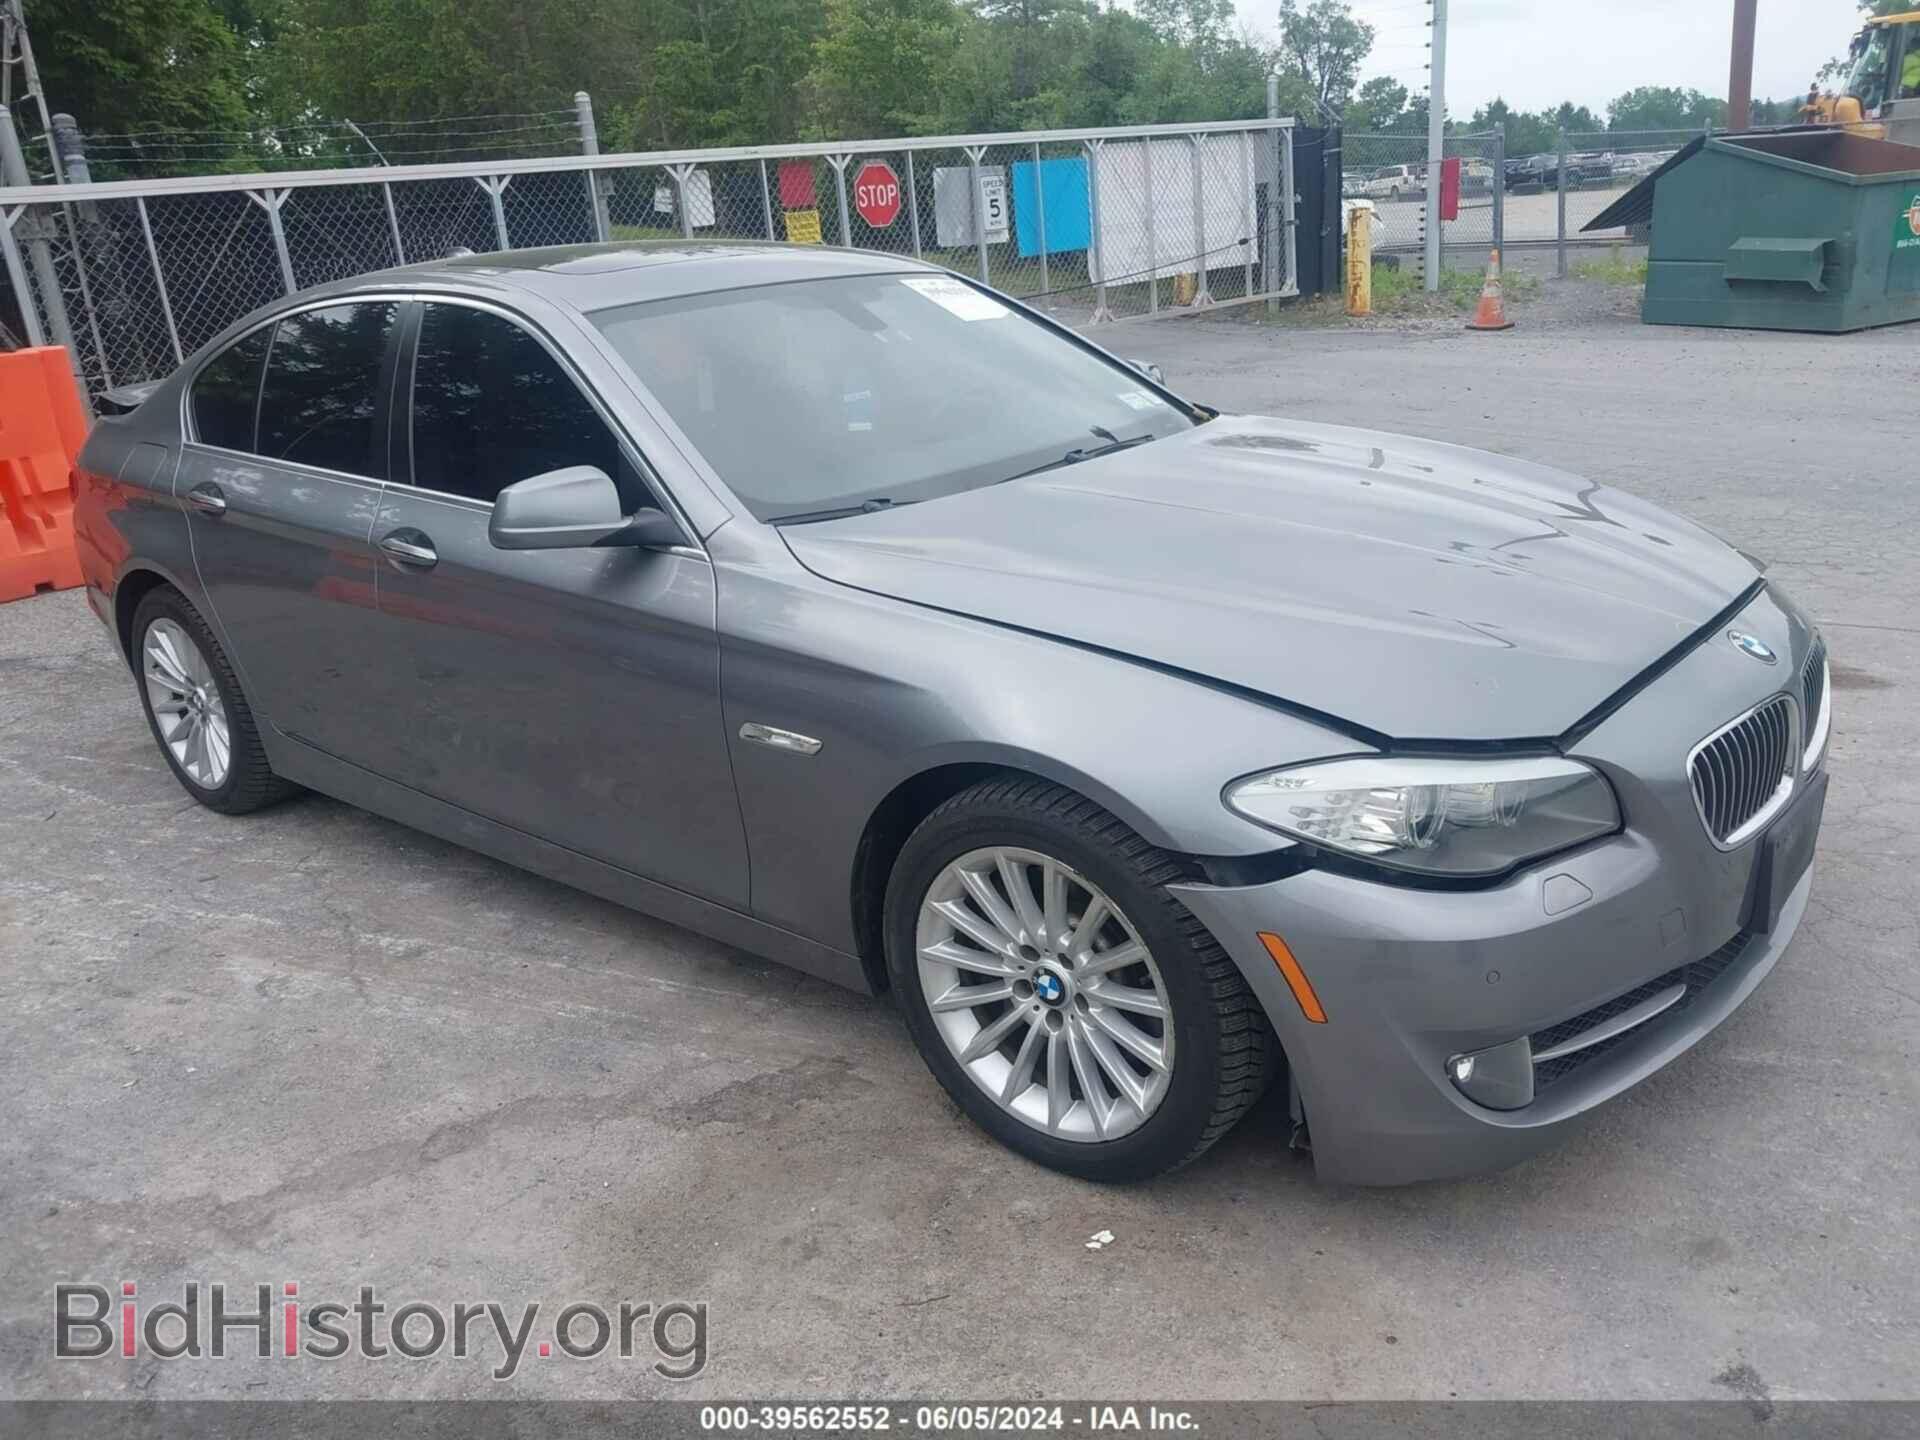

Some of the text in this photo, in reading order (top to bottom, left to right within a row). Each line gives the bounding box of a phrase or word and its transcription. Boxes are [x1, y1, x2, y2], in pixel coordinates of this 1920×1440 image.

[983, 179, 1003, 188] SPEED
[858, 184, 897, 207] STOP
[985, 188, 1001, 196] LIMIT
[990, 198, 1001, 218] 5
